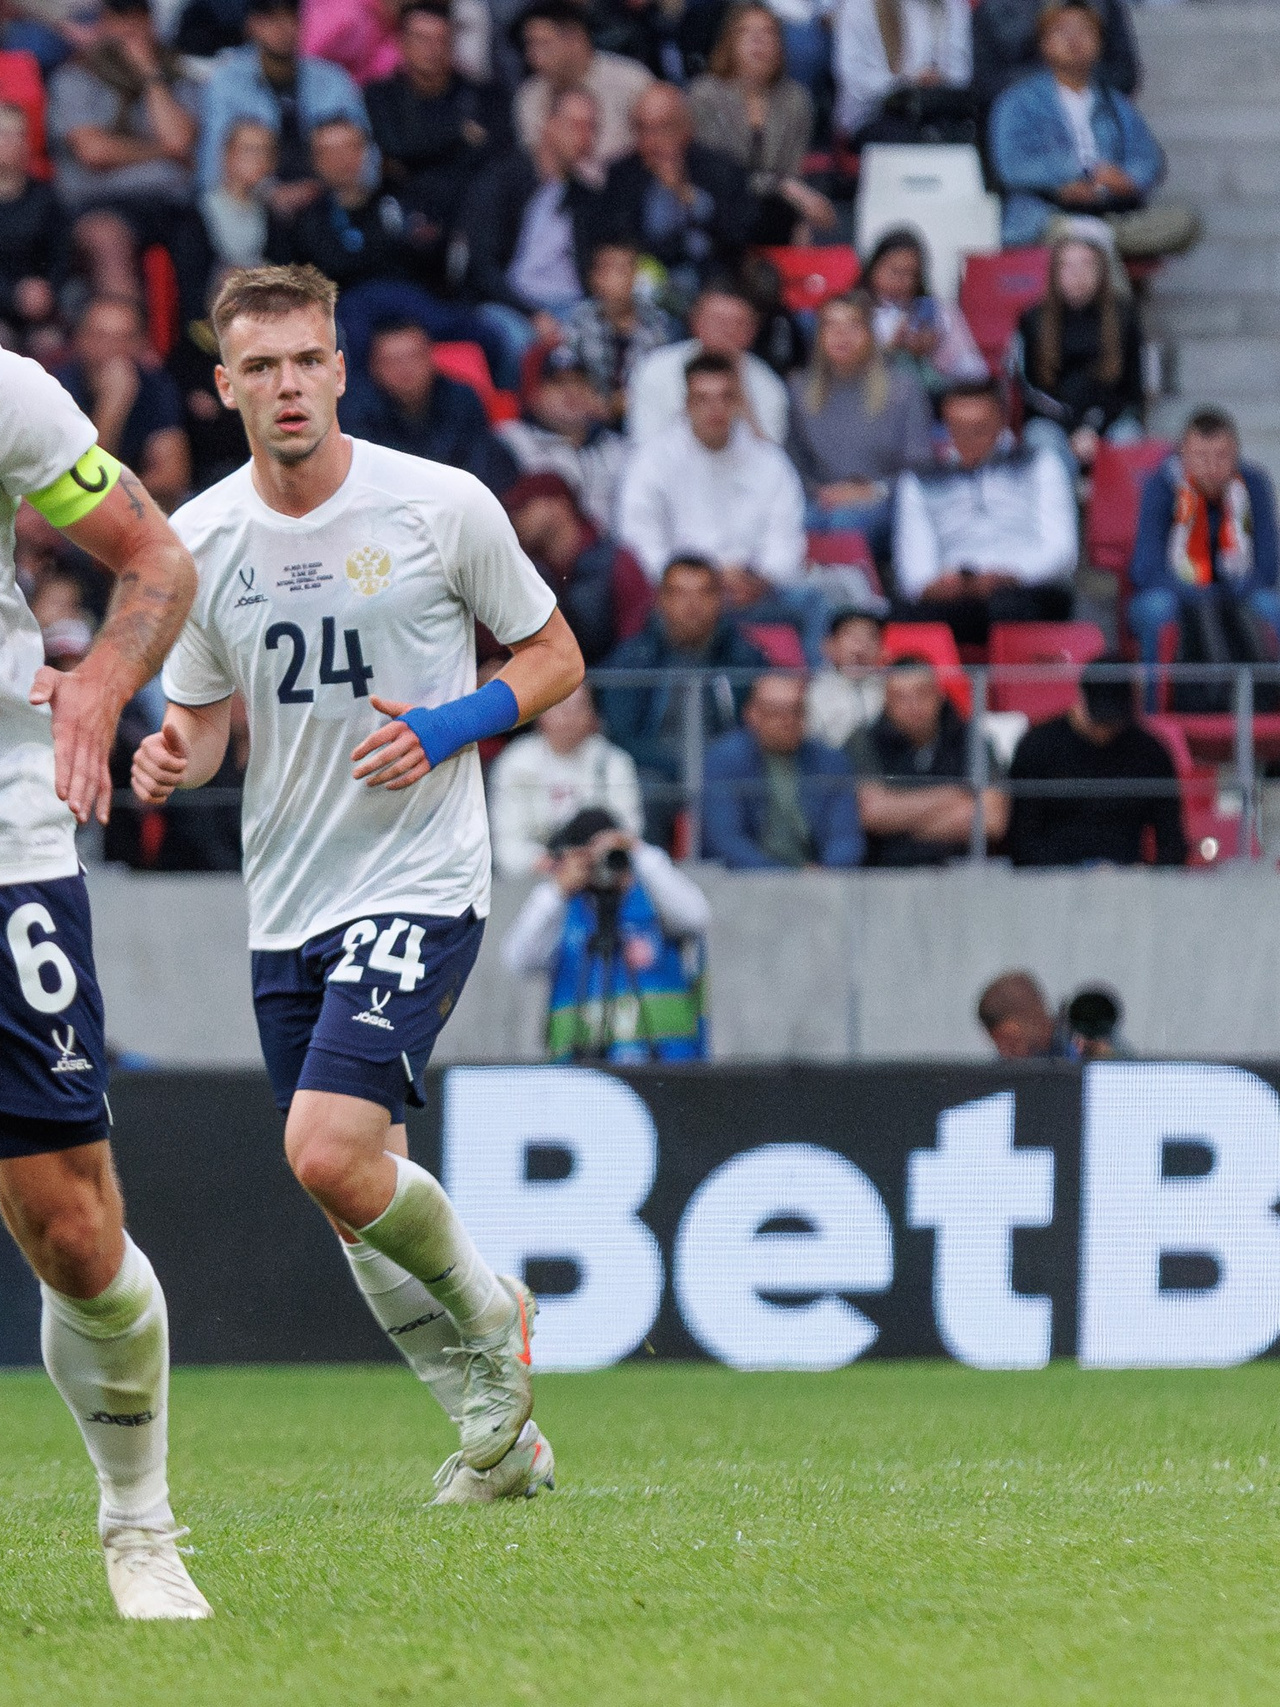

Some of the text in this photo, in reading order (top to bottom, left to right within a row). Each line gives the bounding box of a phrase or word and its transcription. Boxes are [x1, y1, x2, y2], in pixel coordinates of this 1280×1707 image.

[265, 616, 374, 704] 24
[6, 902, 77, 1014] 6
[327, 917, 426, 991] 24
[443, 1062, 1280, 1371] BetB
